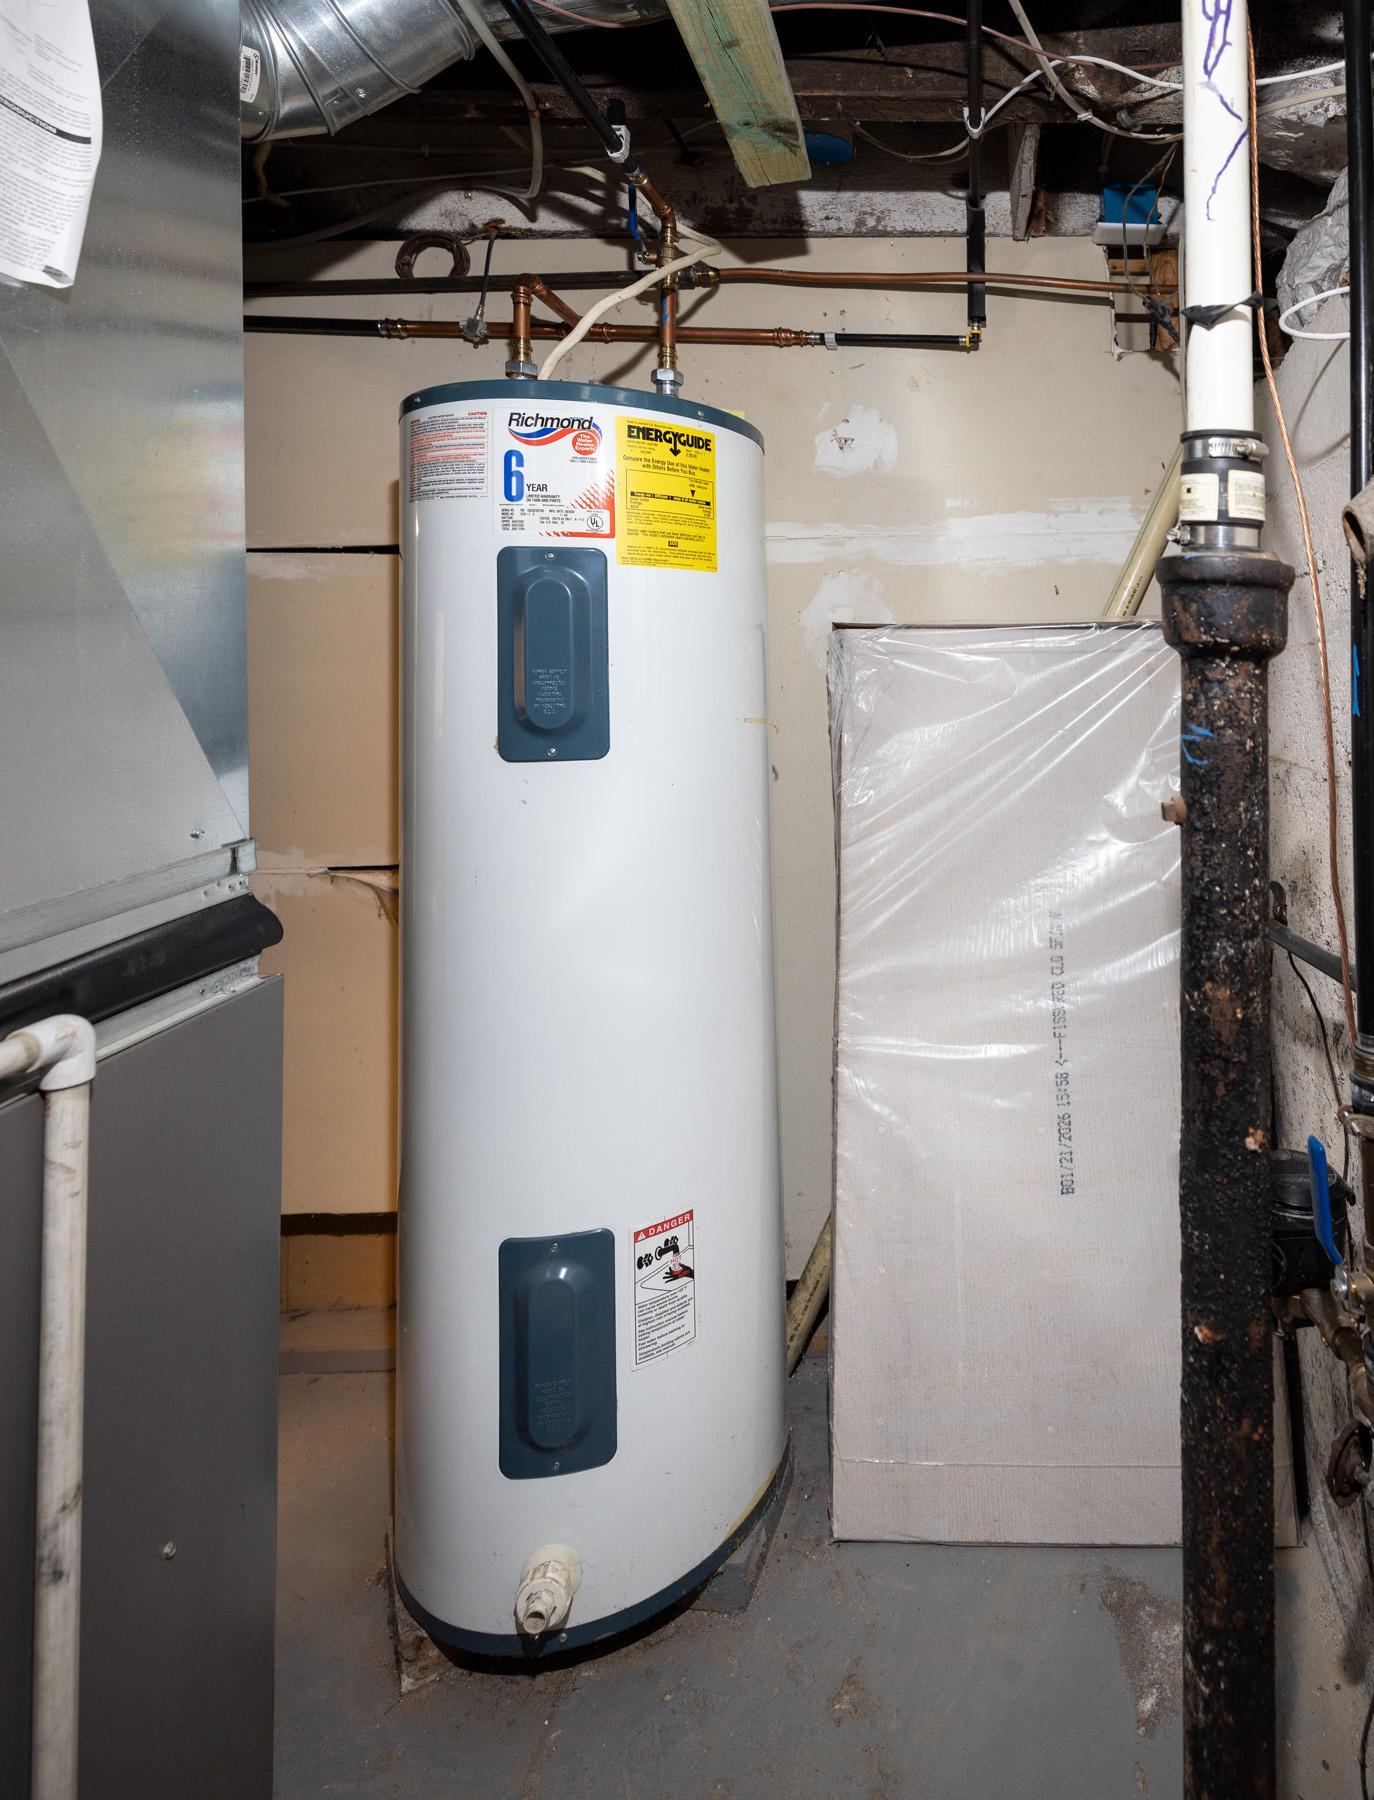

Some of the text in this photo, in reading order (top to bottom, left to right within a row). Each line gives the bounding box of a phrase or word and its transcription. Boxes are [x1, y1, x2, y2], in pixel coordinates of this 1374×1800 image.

[508, 412, 594, 430] Richmond
[627, 424, 711, 453] ENERGYGUIDE
[623, 454, 643, 462] Compare
[652, 457, 666, 466] Energy
[504, 450, 524, 502] 6
[649, 1214, 690, 1236] DANGER
[670, 1254, 682, 1264] HOT
